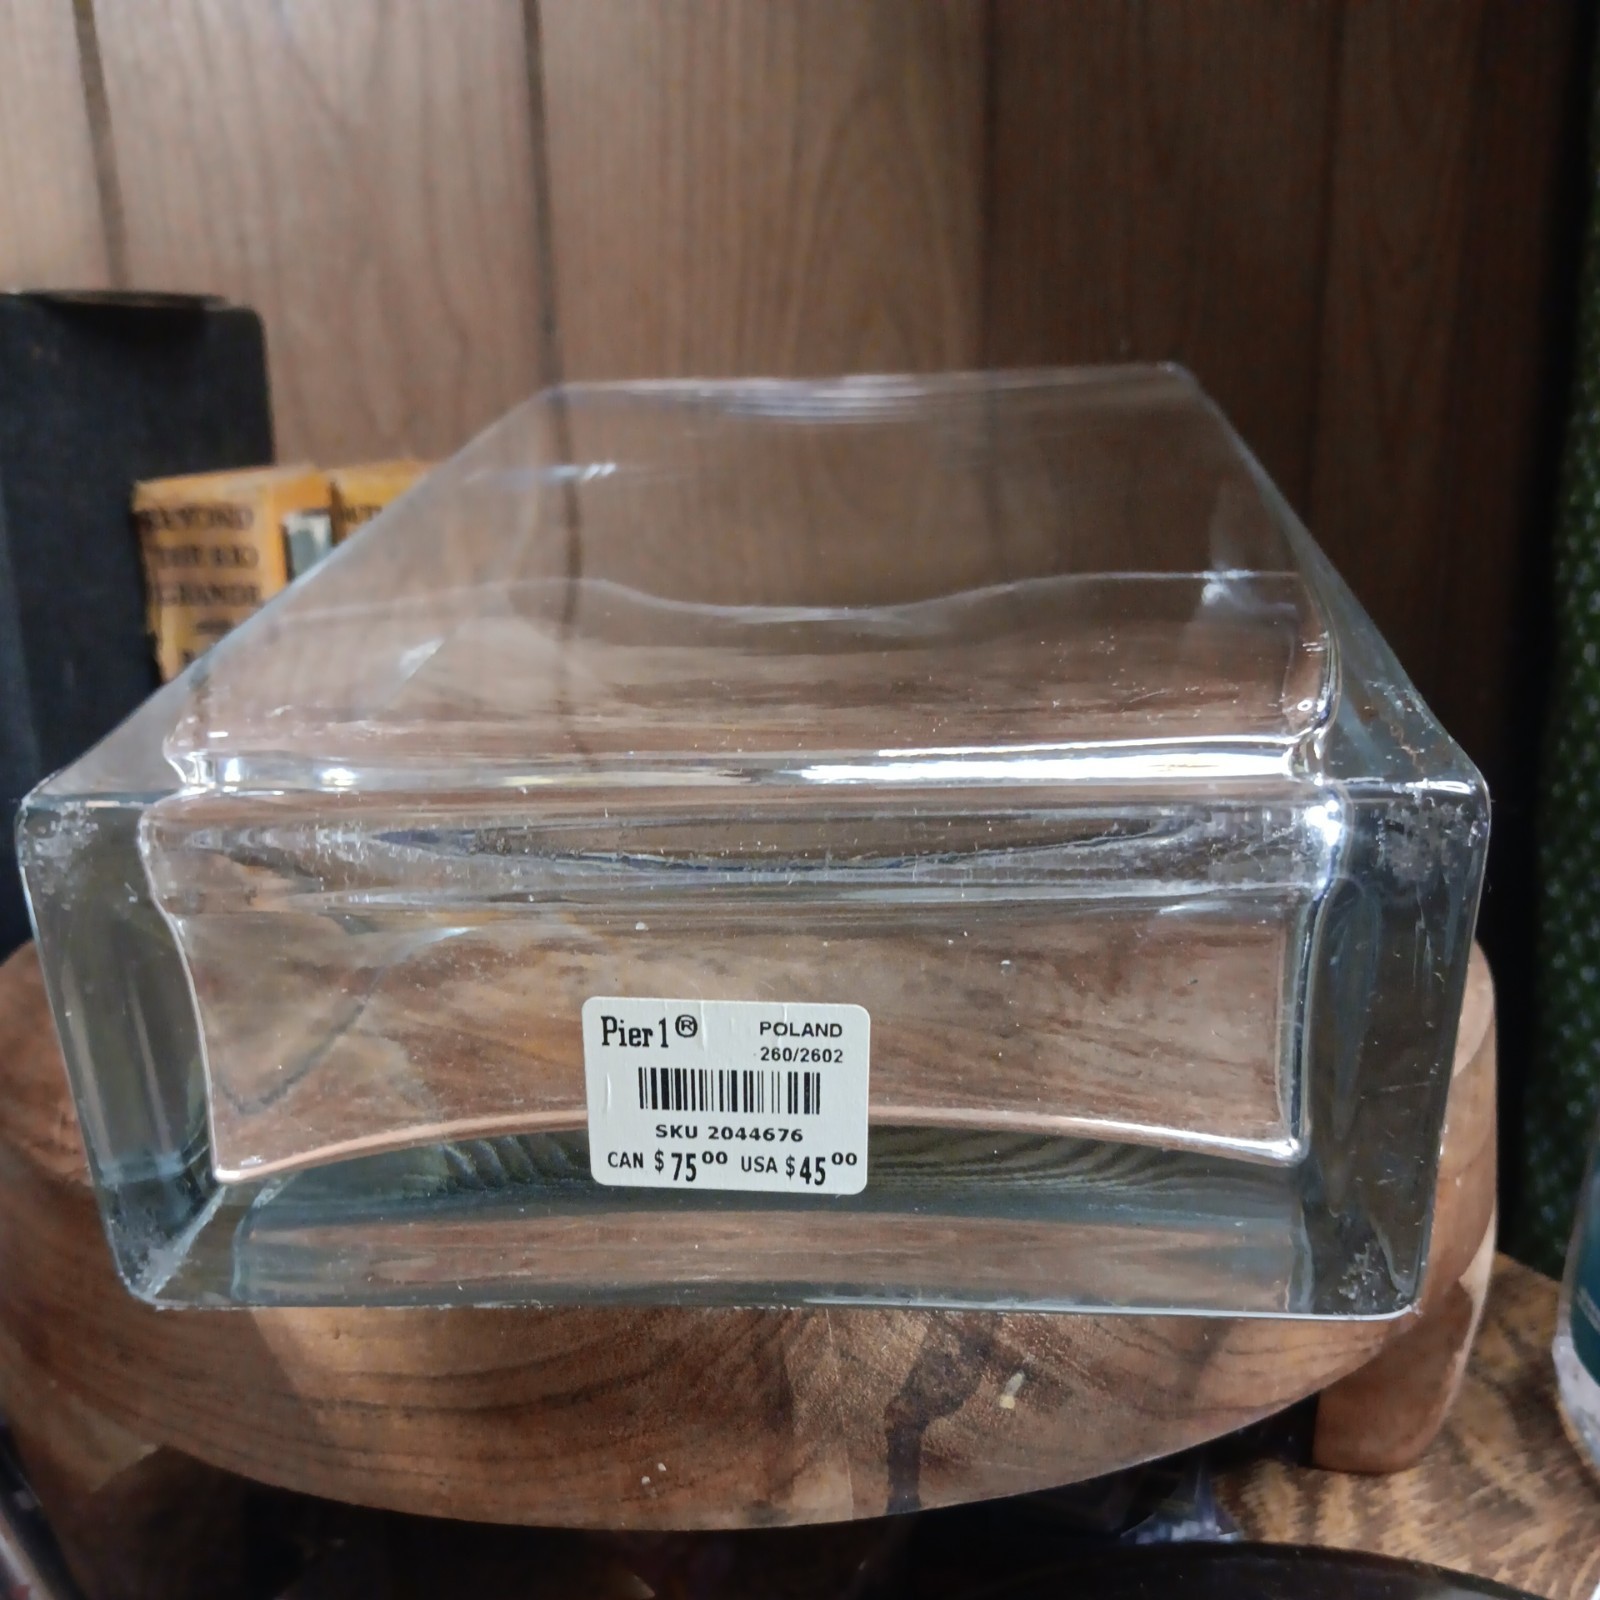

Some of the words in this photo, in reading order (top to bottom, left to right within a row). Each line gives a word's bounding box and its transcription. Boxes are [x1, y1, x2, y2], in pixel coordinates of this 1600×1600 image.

[600, 1015, 654, 1048] Pier
[759, 1021, 843, 1038] POLAND
[760, 1046, 843, 1063] 260/2602
[655, 1124, 698, 1139] SKU
[708, 1126, 803, 1143] 2044676
[607, 1151, 644, 1169] CAN
[741, 1155, 778, 1174] USA
